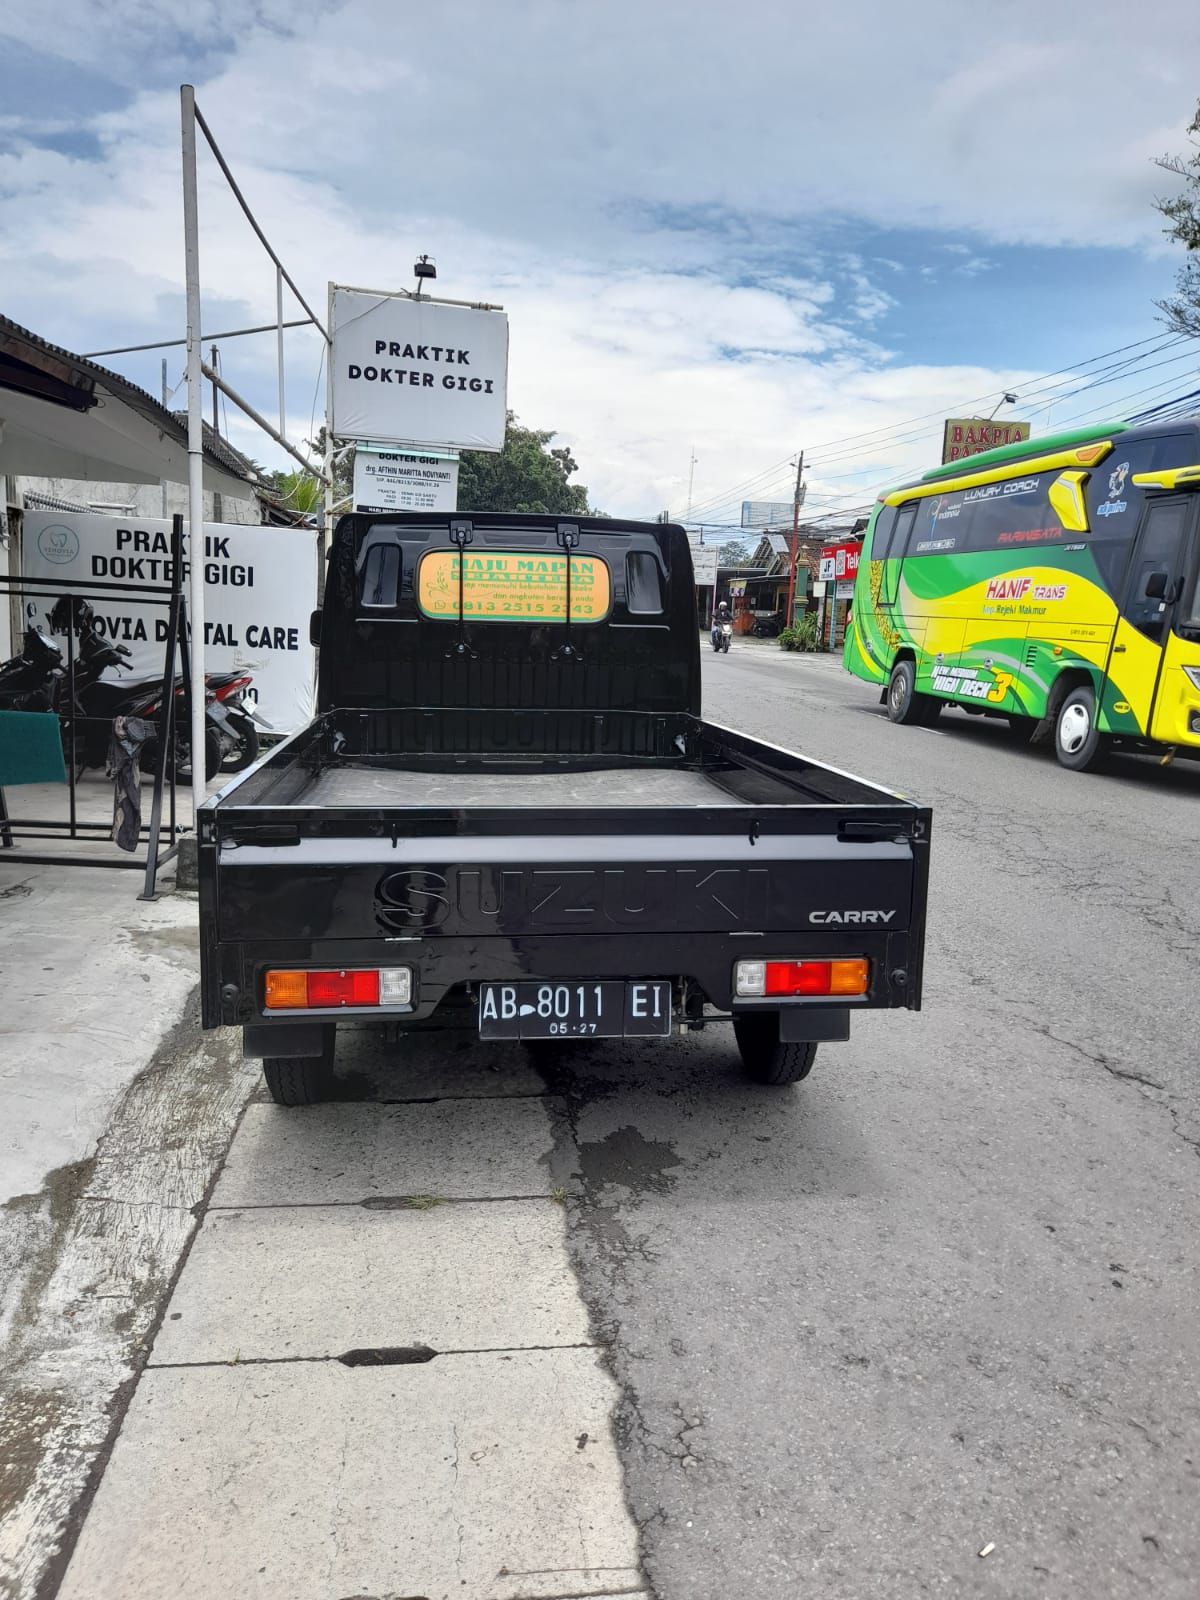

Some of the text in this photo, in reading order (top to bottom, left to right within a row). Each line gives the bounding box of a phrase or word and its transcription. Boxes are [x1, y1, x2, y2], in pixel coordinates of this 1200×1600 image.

[375, 340, 470, 365] PRAKTIK
[348, 364, 494, 394] DOKTER GIGI
[951, 425, 1023, 445] BAKPIA
[378, 453, 439, 465] DOKTER GIGI
[964, 478, 1040, 501] LUXURY COACH
[116, 529, 230, 558] PRAIK
[204, 563, 254, 588] GIGI
[452, 559, 593, 574] MAJU MAPAN
[985, 579, 1066, 600] HANIF TRANS
[503, 603, 544, 613] 2515
[45, 613, 299, 651] OVIA DTAL CARE
[987, 672, 1013, 703] 3
[377, 868, 770, 928] SUZUKI
[808, 909, 896, 924] CARRY
[483, 985, 661, 1020] AB 8011 EI
